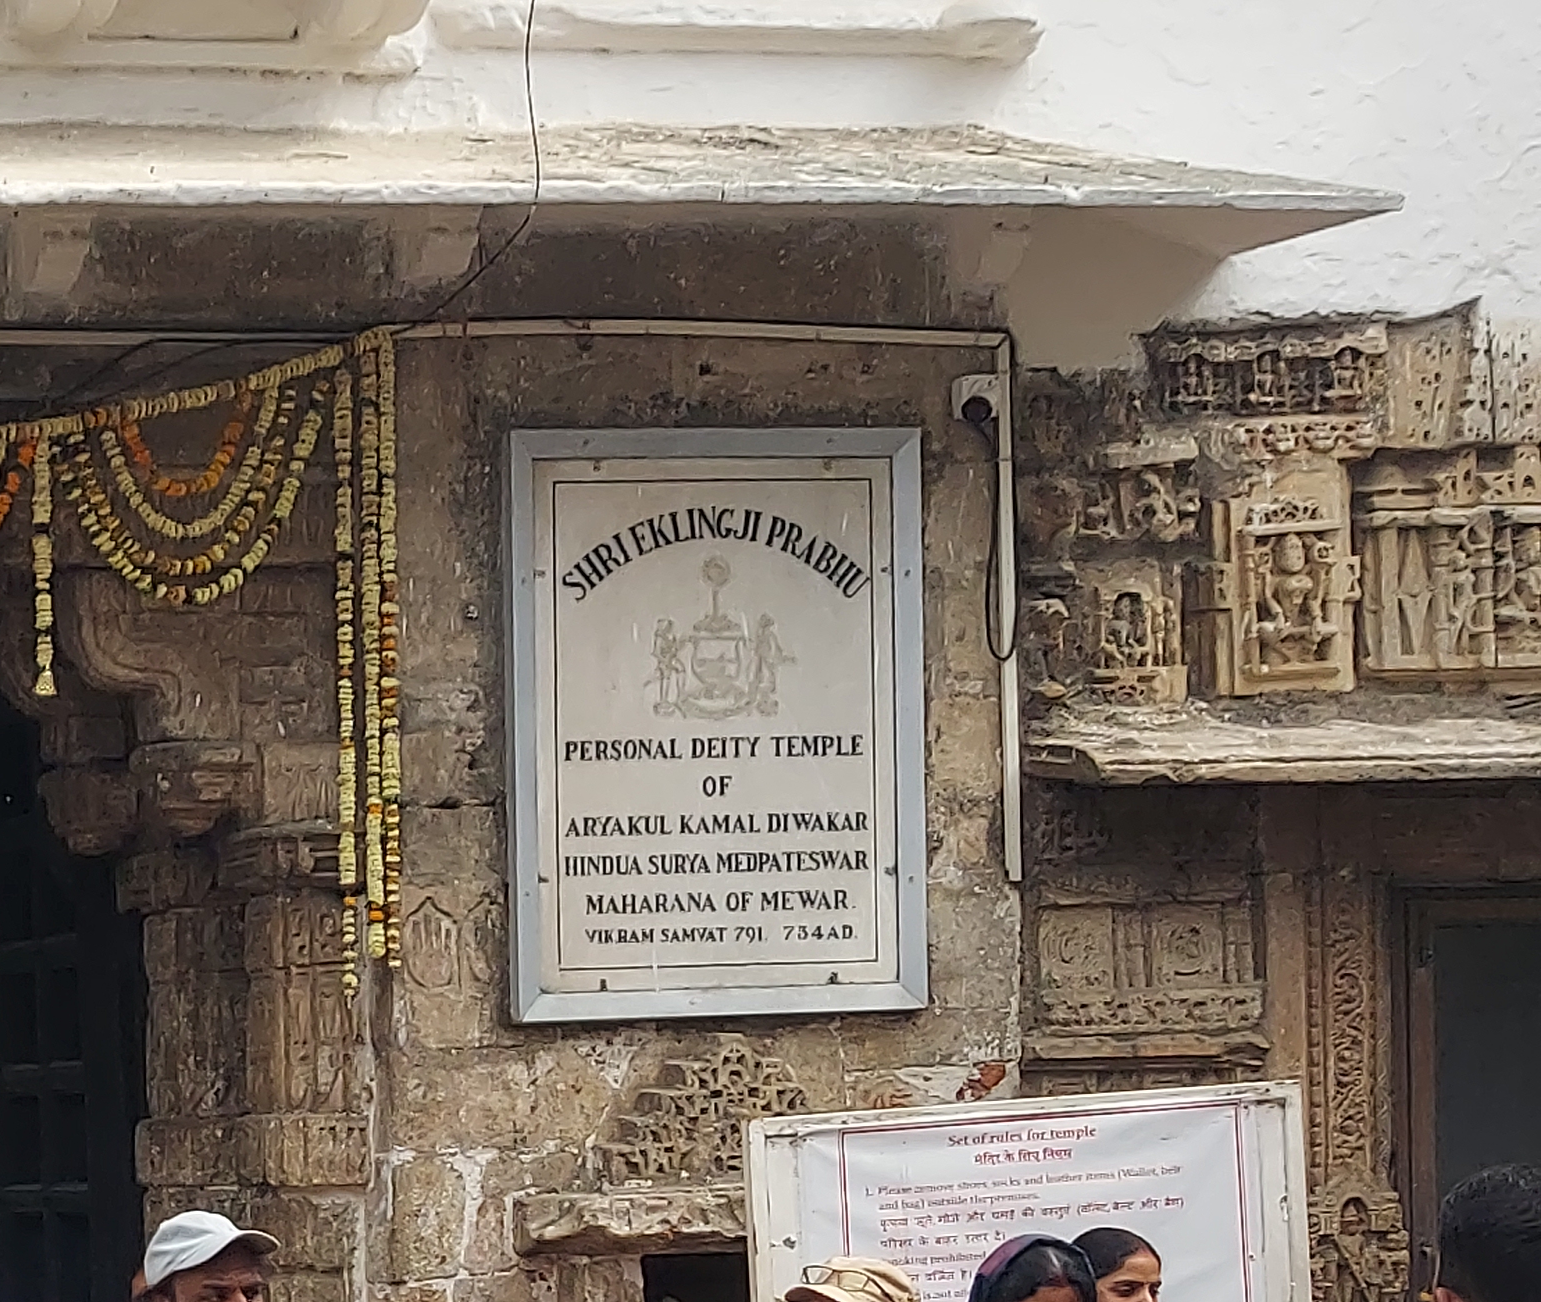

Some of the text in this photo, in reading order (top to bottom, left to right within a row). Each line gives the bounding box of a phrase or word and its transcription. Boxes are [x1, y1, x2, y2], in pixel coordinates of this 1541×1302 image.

[562, 506, 870, 603] SHRI EKLINGJI PRABHU
[564, 735, 864, 762] PERSONAL DEITY TEMPLE
[702, 776, 733, 797] OF
[565, 811, 868, 837] ARYAKUL KAMAL DIWAKAR
[565, 851, 868, 876] HINDUA SURYA MEDPATESWAR
[586, 892, 716, 915] MAHARANA
[726, 891, 753, 912] OF
[585, 928, 654, 944] VIKRAM
[661, 926, 727, 943] SAMVAT
[972, 1132, 987, 1144] of
